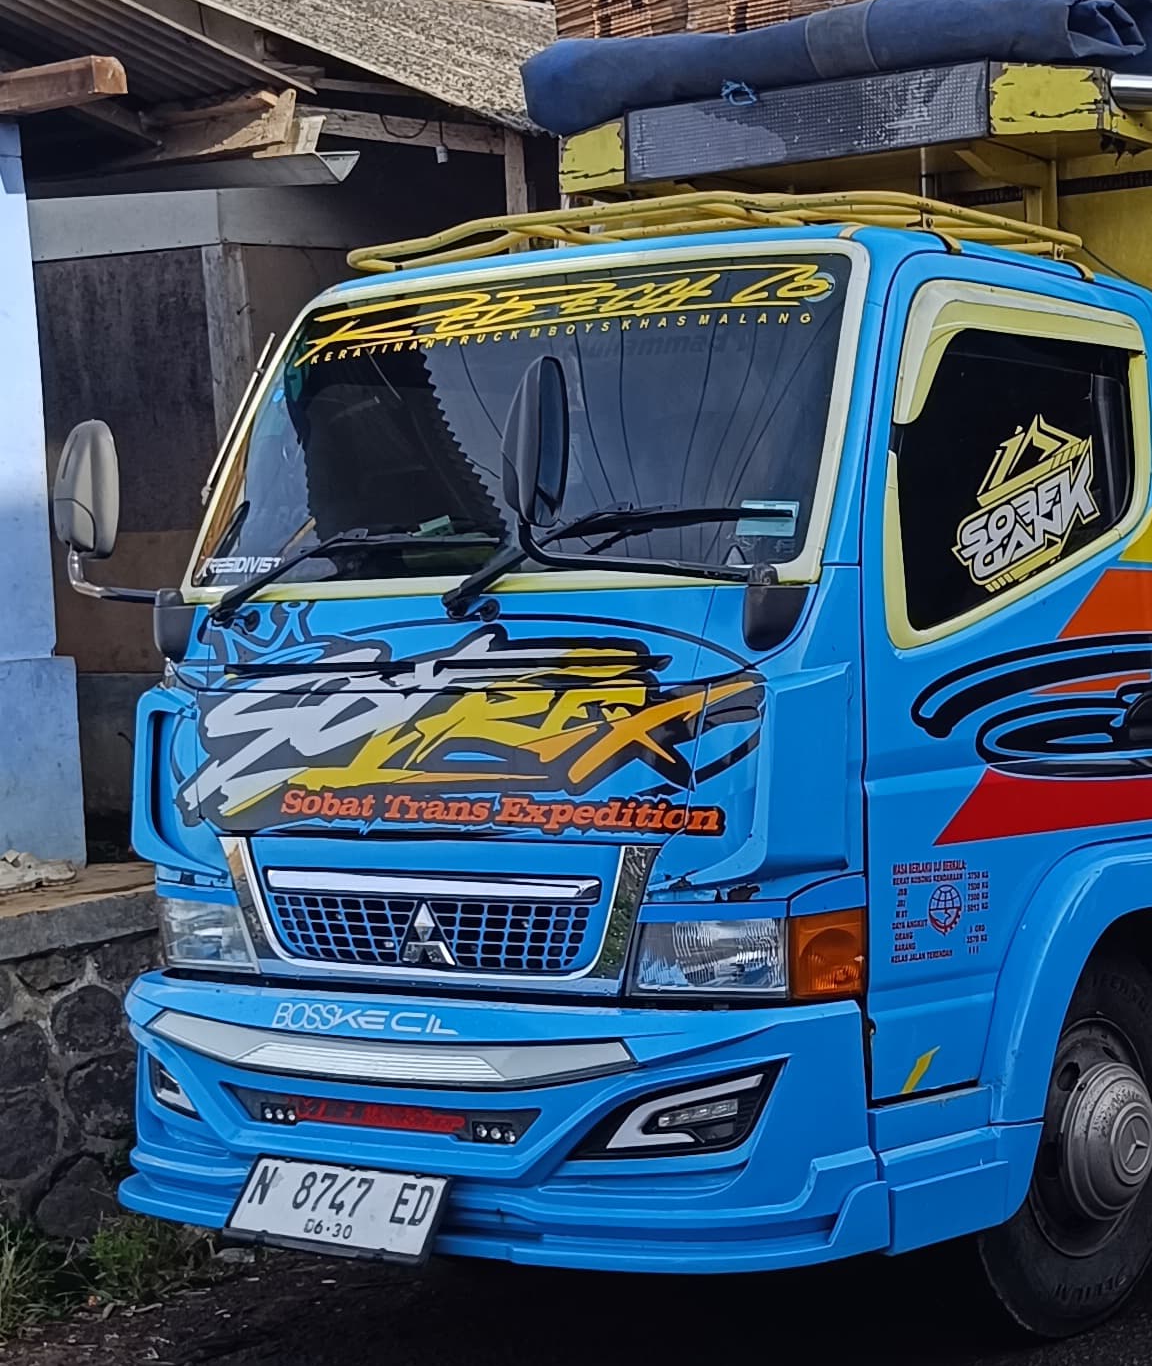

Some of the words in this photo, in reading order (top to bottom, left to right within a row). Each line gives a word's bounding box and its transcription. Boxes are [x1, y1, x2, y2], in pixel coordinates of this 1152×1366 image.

[444, 329, 519, 347] TRUCK
[529, 321, 611, 338] MBOYS
[621, 315, 687, 331] KHAS
[698, 312, 812, 326] MALANG
[281, 789, 375, 819] Sobat
[384, 794, 490, 823] Trans
[499, 797, 719, 831] Expedition
[247, 1165, 279, 1205] N
[291, 1171, 375, 1218] 8747
[389, 1182, 434, 1227] ED
